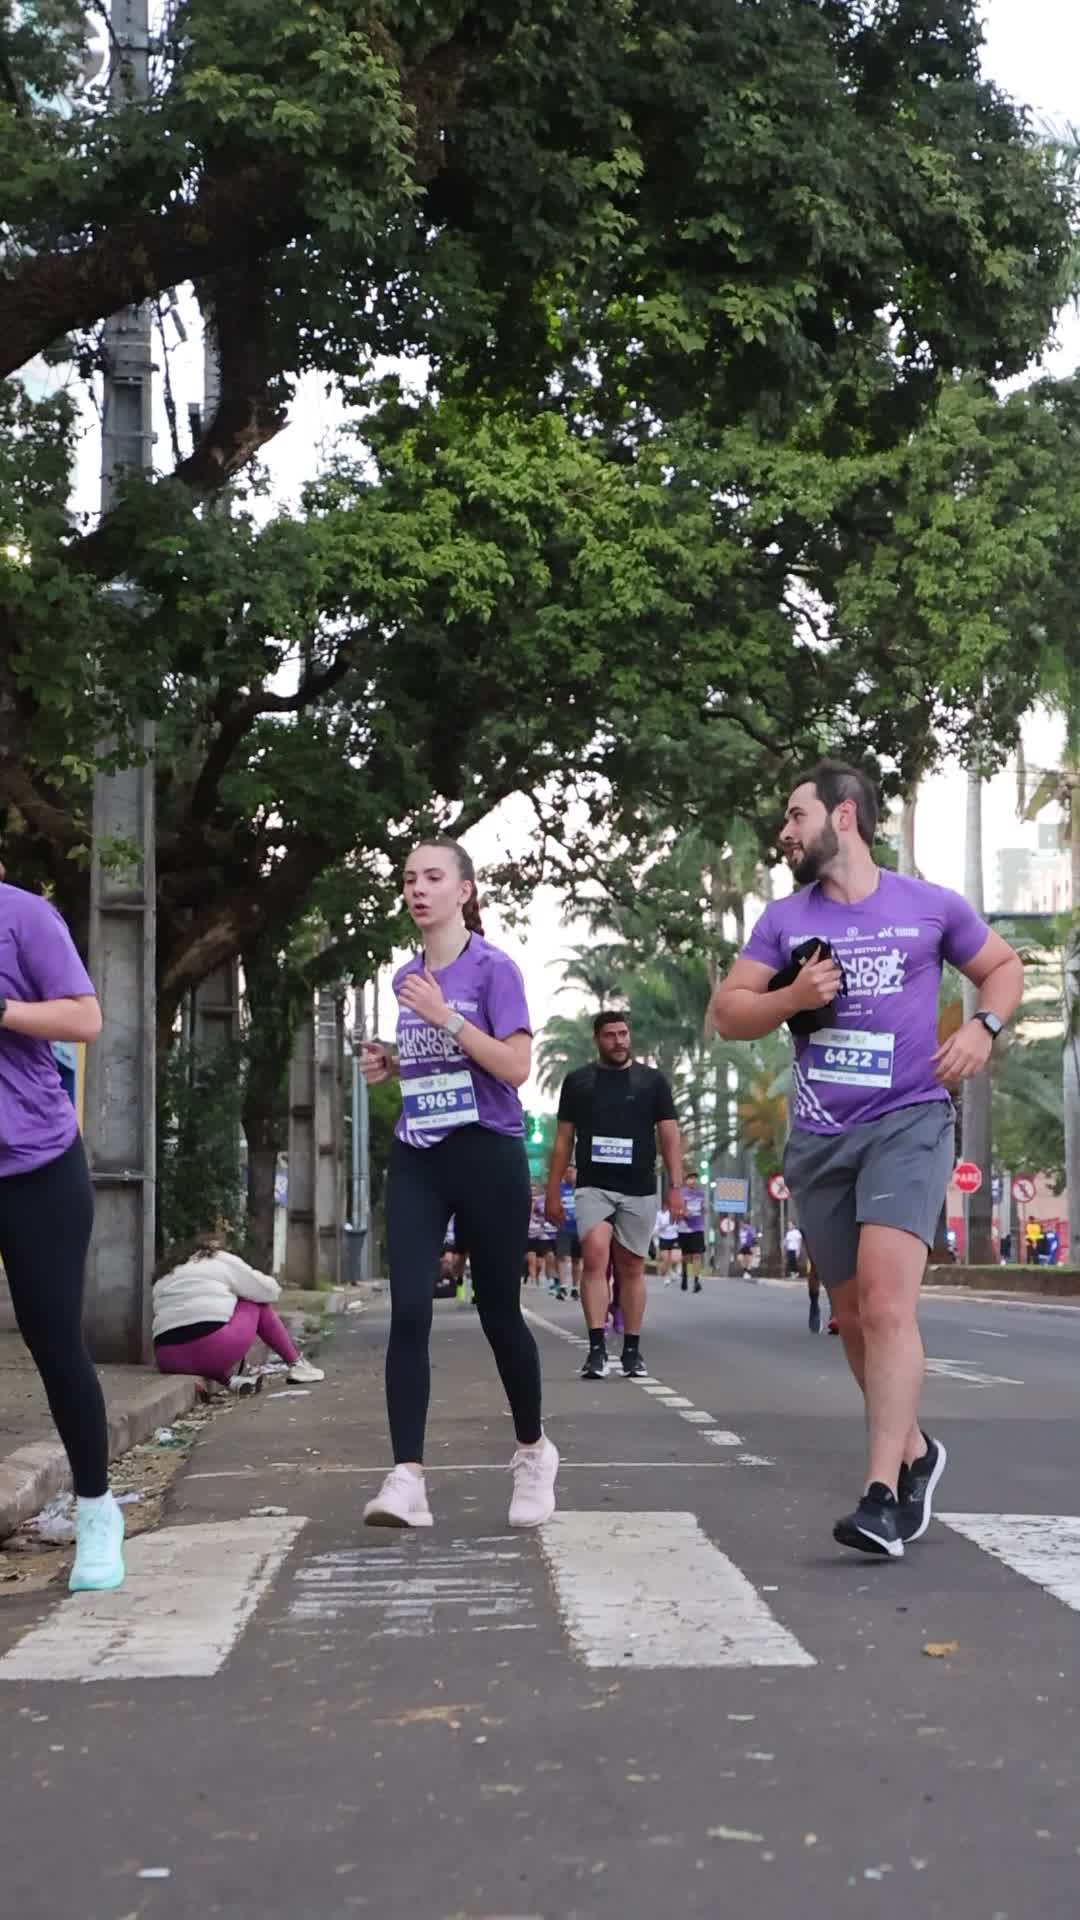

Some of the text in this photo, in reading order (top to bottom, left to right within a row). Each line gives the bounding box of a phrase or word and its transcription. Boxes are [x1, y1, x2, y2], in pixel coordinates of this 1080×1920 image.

[824, 1048, 873, 1067] 6422
[417, 1090, 457, 1111] 5965
[953, 1172, 979, 1184] PARE
